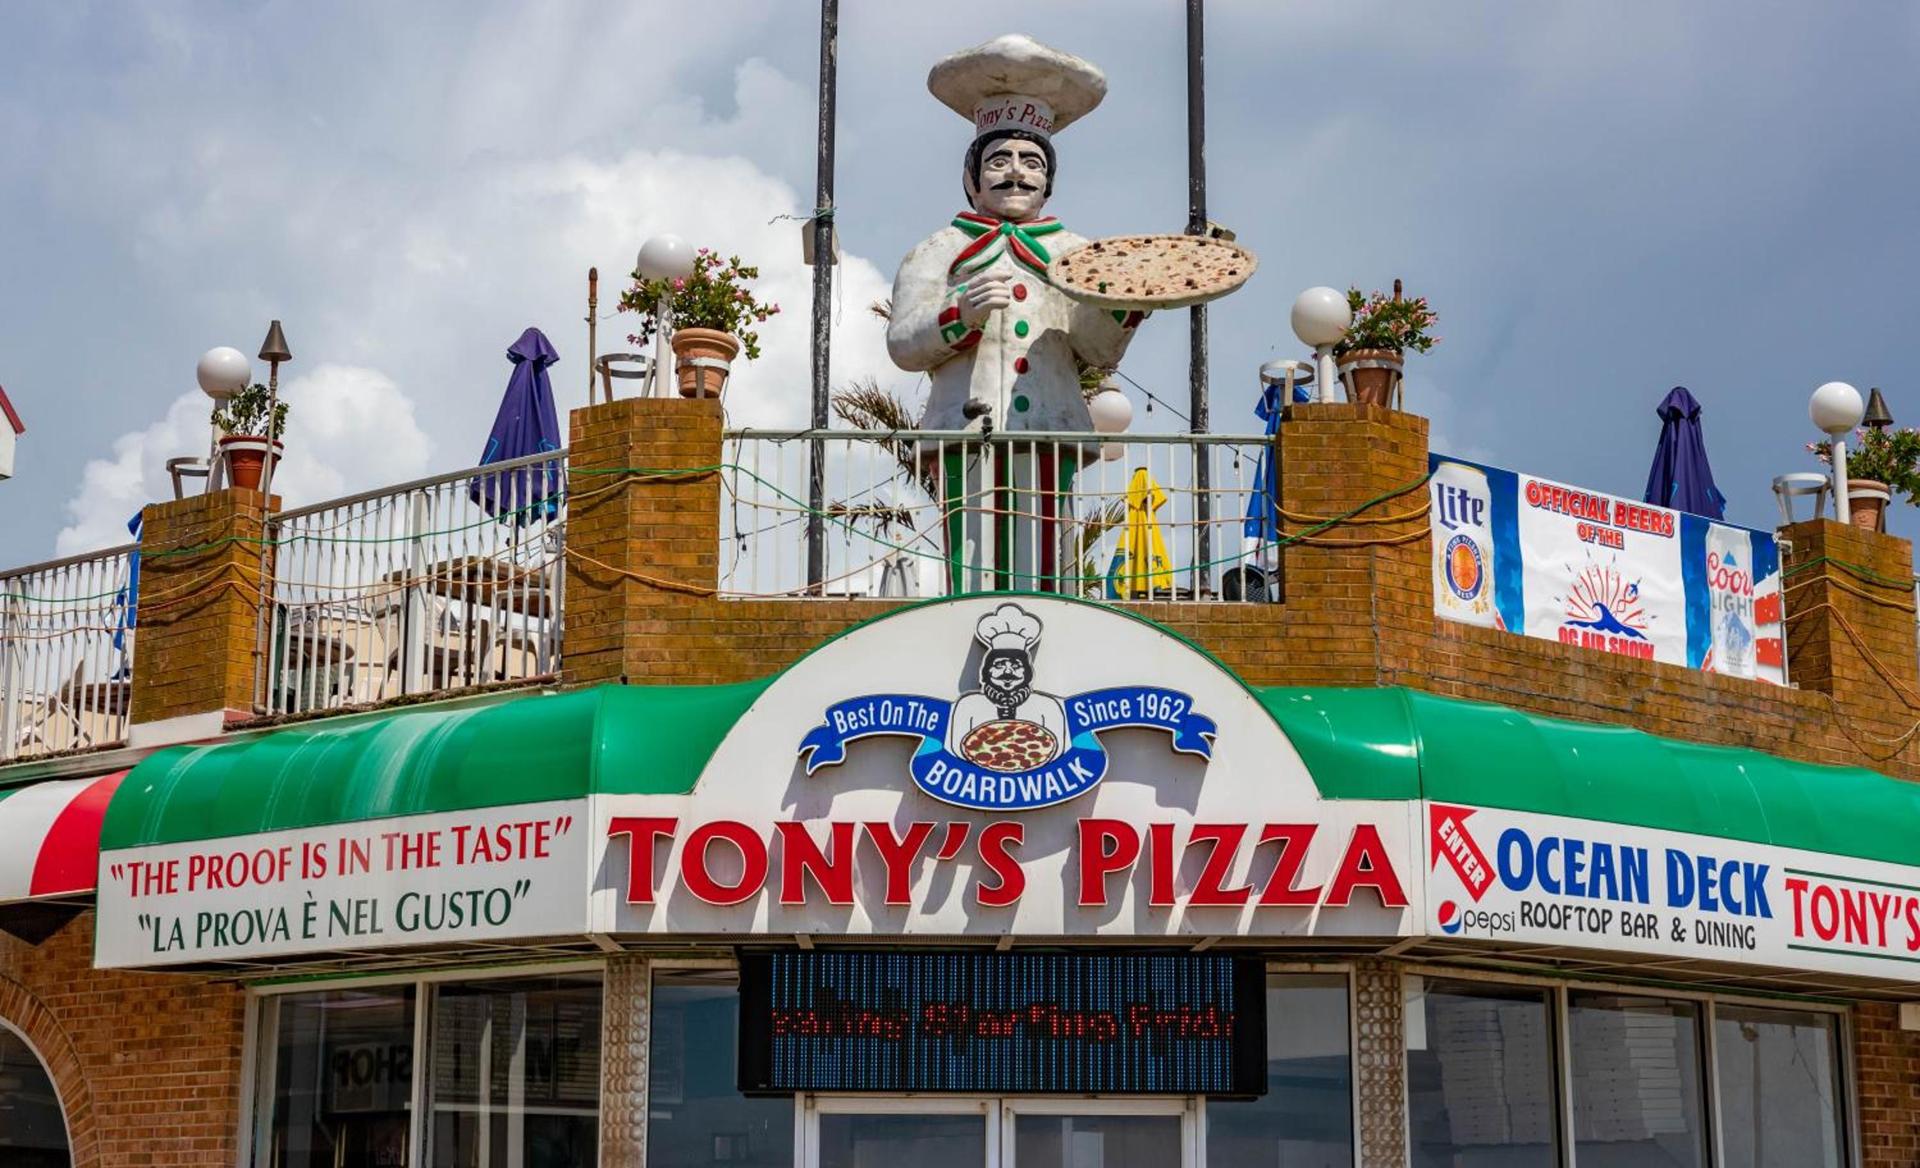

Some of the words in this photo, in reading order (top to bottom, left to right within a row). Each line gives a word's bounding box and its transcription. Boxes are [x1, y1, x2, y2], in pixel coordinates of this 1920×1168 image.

[1436, 483, 1484, 531] Lite
[1526, 480, 1611, 525] OFFICIAL
[1613, 501, 1674, 538] BEERS
[1577, 522, 1595, 543] OF
[1596, 527, 1624, 550] THE
[1582, 631, 1605, 652] AIR
[1608, 636, 1655, 661] SHOW
[832, 705, 876, 734] Best
[880, 699, 905, 726] On
[906, 700, 939, 732] The
[1074, 697, 1132, 727] Since
[1136, 693, 1185, 724] 1962
[925, 756, 1094, 803] BOARDWALK
[188, 846, 292, 892] PROOF
[301, 842, 327, 880] IS
[338, 837, 371, 875] IN
[381, 830, 441, 872] THE
[606, 817, 1026, 907] TONY'S
[1077, 817, 1411, 908] PIZZA
[1437, 816, 1486, 891] ENTER
[1497, 828, 1650, 904] OCEAN
[1666, 848, 1773, 920] DECK
[195, 906, 291, 949] PROVA
[302, 891, 317, 939] È
[328, 898, 383, 937] NEL
[1464, 911, 1515, 937] pepsi
[1521, 900, 1613, 934] ROOFTOP
[1621, 912, 1660, 940] BAR
[1671, 917, 1687, 941] &
[1695, 919, 1757, 951] DINING
[1785, 878, 1920, 952] TONY'S
